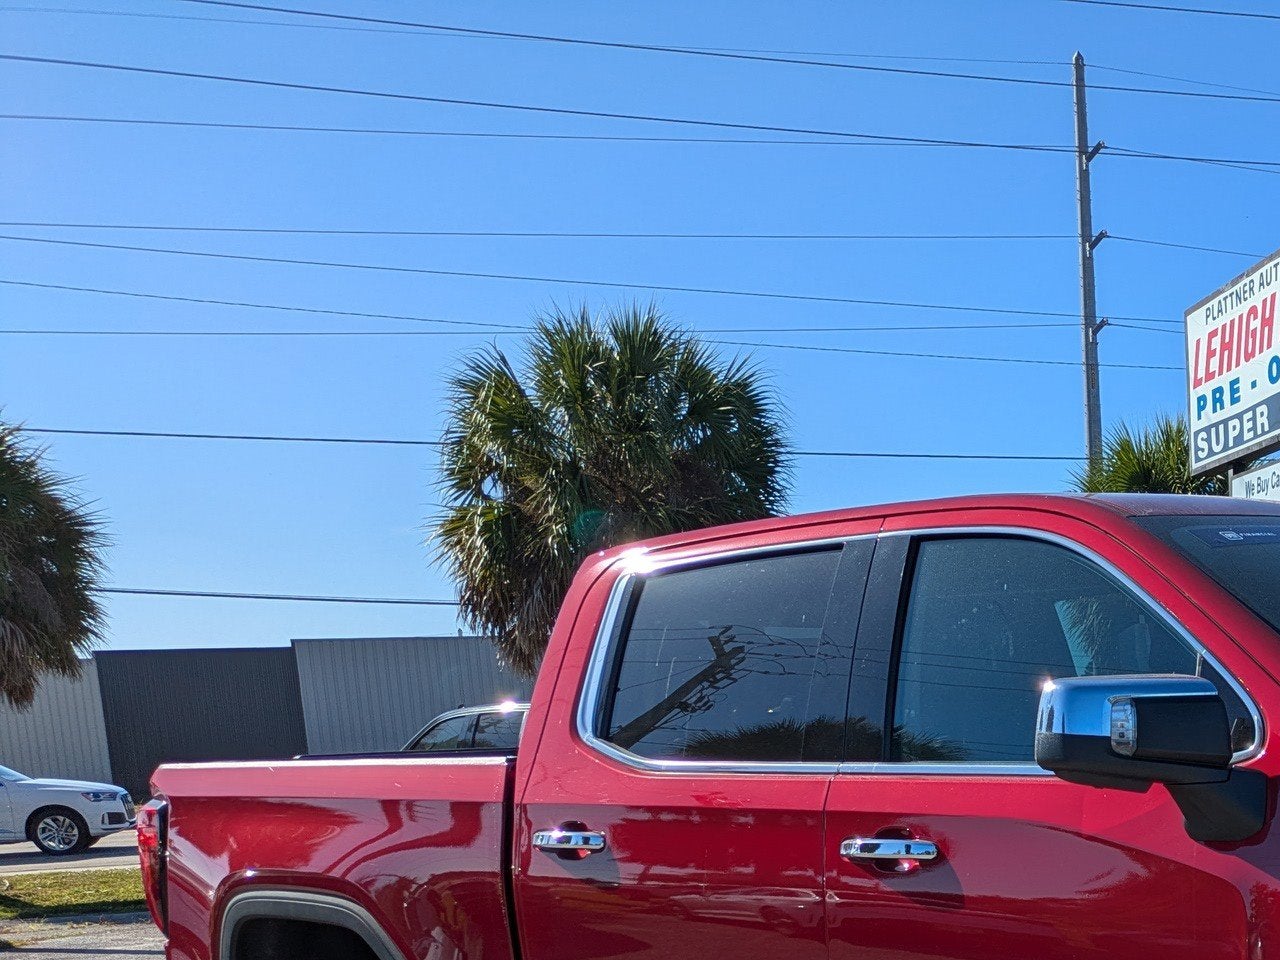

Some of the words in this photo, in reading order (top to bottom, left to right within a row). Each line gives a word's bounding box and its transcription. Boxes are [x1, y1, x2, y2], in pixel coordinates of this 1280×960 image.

[1205, 279, 1255, 325] PLATTNER
[1193, 292, 1276, 389] LEHIGH
[1197, 377, 1241, 421] PRE
[1197, 404, 1269, 459] SUPER
[1245, 480, 1255, 499] We
[1257, 477, 1270, 495] Buy
